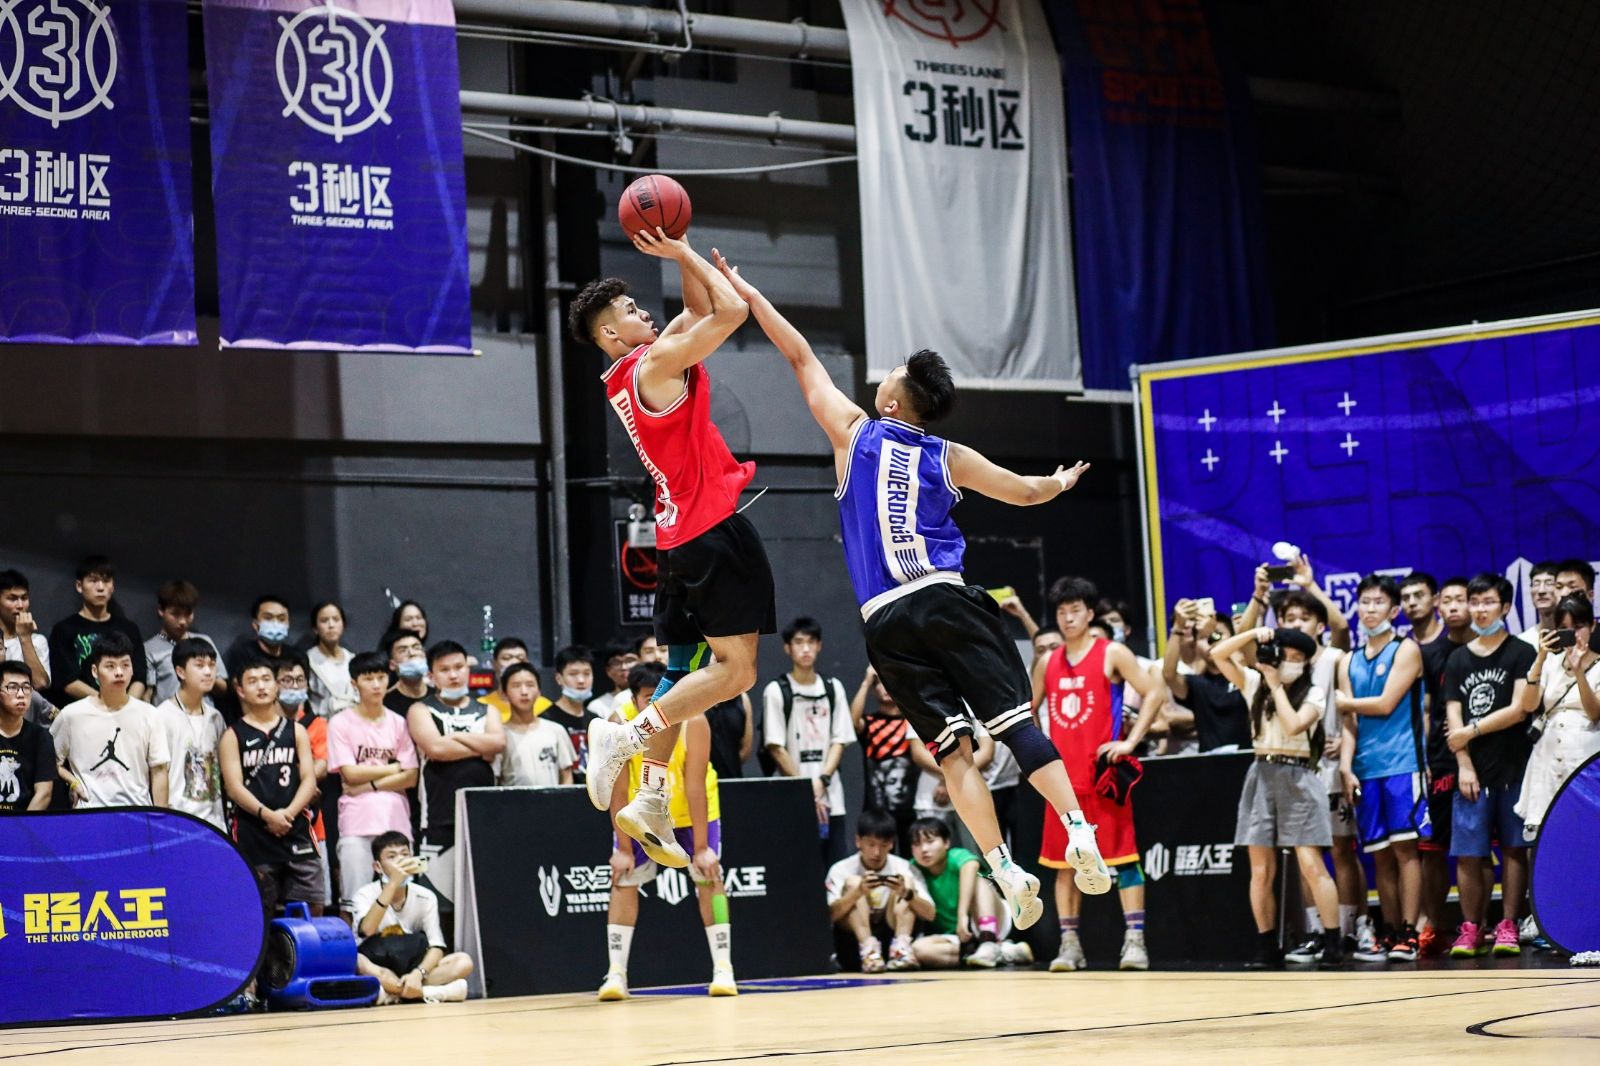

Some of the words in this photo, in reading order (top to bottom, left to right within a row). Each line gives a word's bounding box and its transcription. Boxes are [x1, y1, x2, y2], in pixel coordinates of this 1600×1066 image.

[902, 80, 1025, 150] 3秒区
[0, 148, 111, 207] 3秒区
[288, 161, 394, 218] 3秒区
[81, 208, 111, 221] AREA
[366, 219, 395, 231] AREA
[886, 447, 915, 545] UNDERDOGS
[242, 747, 295, 768] MIAMI
[279, 765, 292, 788] 3
[1175, 843, 1235, 869] 路人王
[24, 887, 168, 935] 路人王
[25, 934, 48, 944] THE
[51, 933, 80, 943] KING
[82, 932, 98, 942] OF
[100, 928, 169, 941] UNDERDOGS
